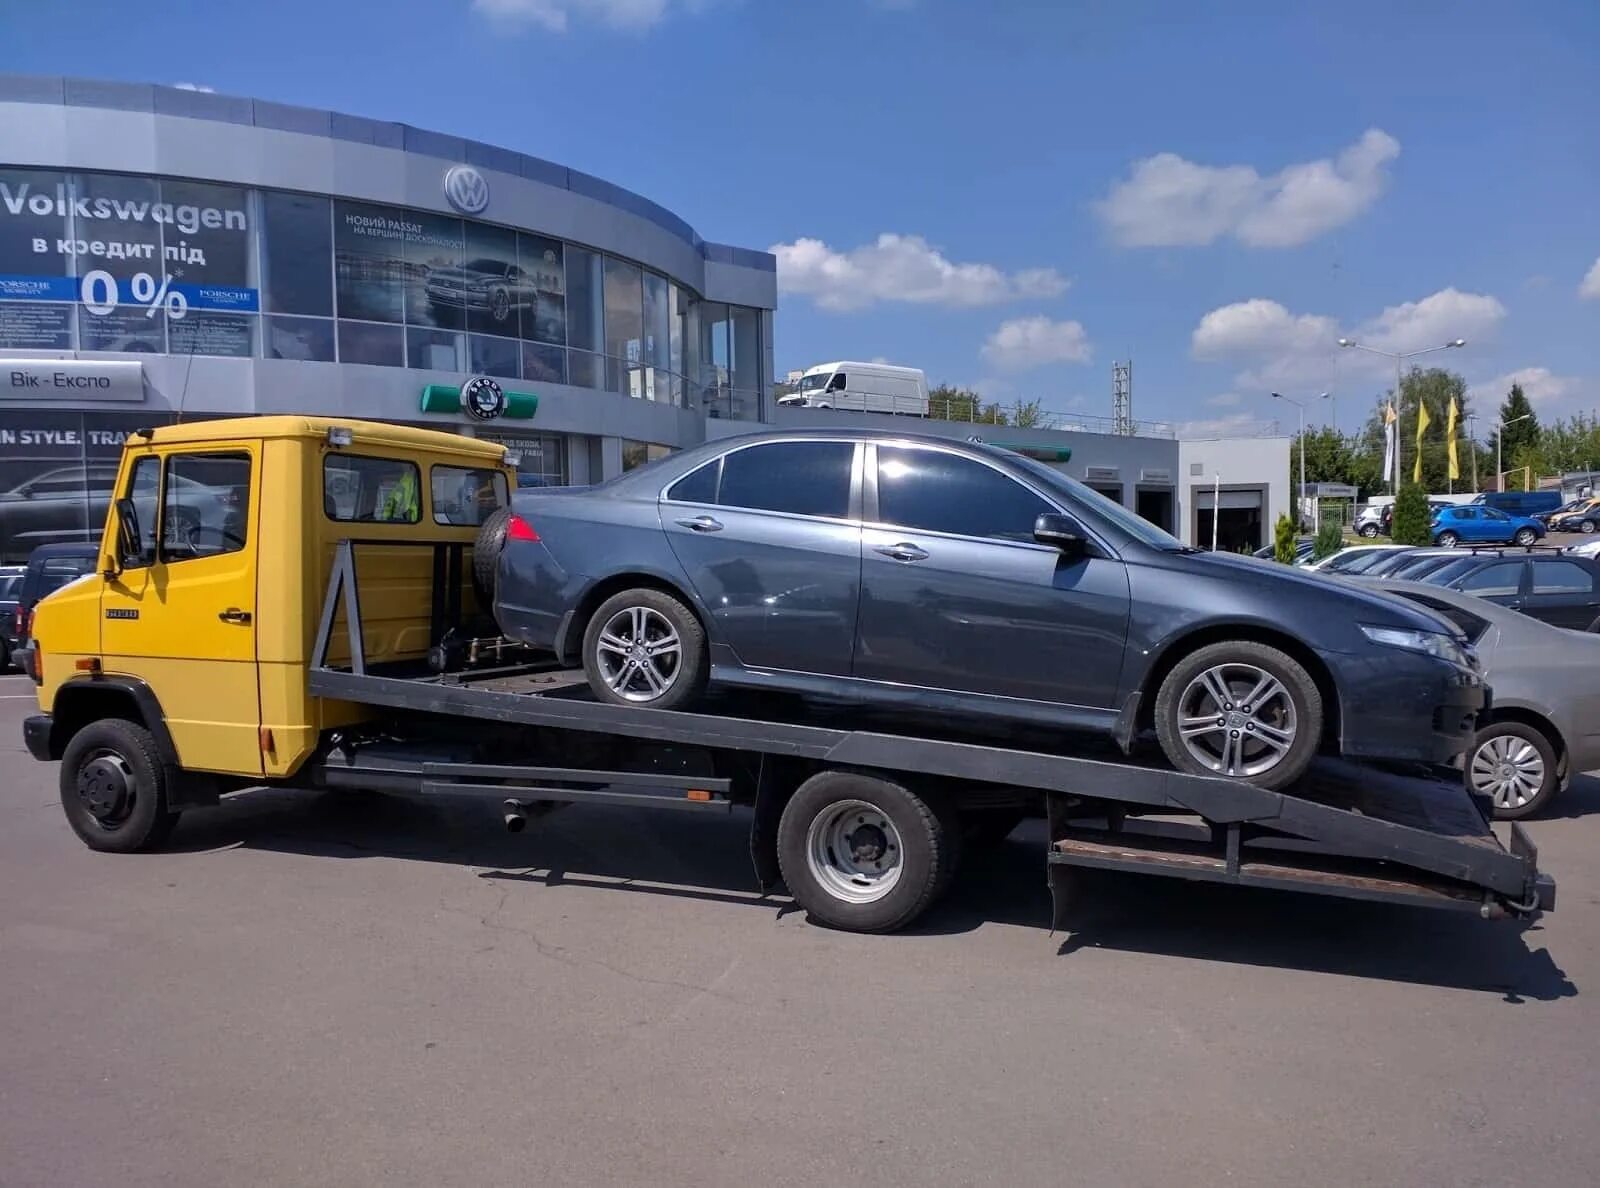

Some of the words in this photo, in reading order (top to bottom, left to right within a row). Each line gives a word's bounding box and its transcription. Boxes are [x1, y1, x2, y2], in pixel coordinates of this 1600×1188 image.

[0, 183, 247, 234] Volkswagen
[345, 214, 385, 228] НОВИЙ
[388, 219, 423, 233] PASSAT
[32, 238, 49, 253] в
[57, 239, 155, 260] кредит
[165, 240, 207, 265] під
[200, 289, 250, 302] PORSCHE
[11, 371, 40, 388] Вік
[54, 372, 111, 388] Експо
[20, 430, 81, 445] STYLE.
